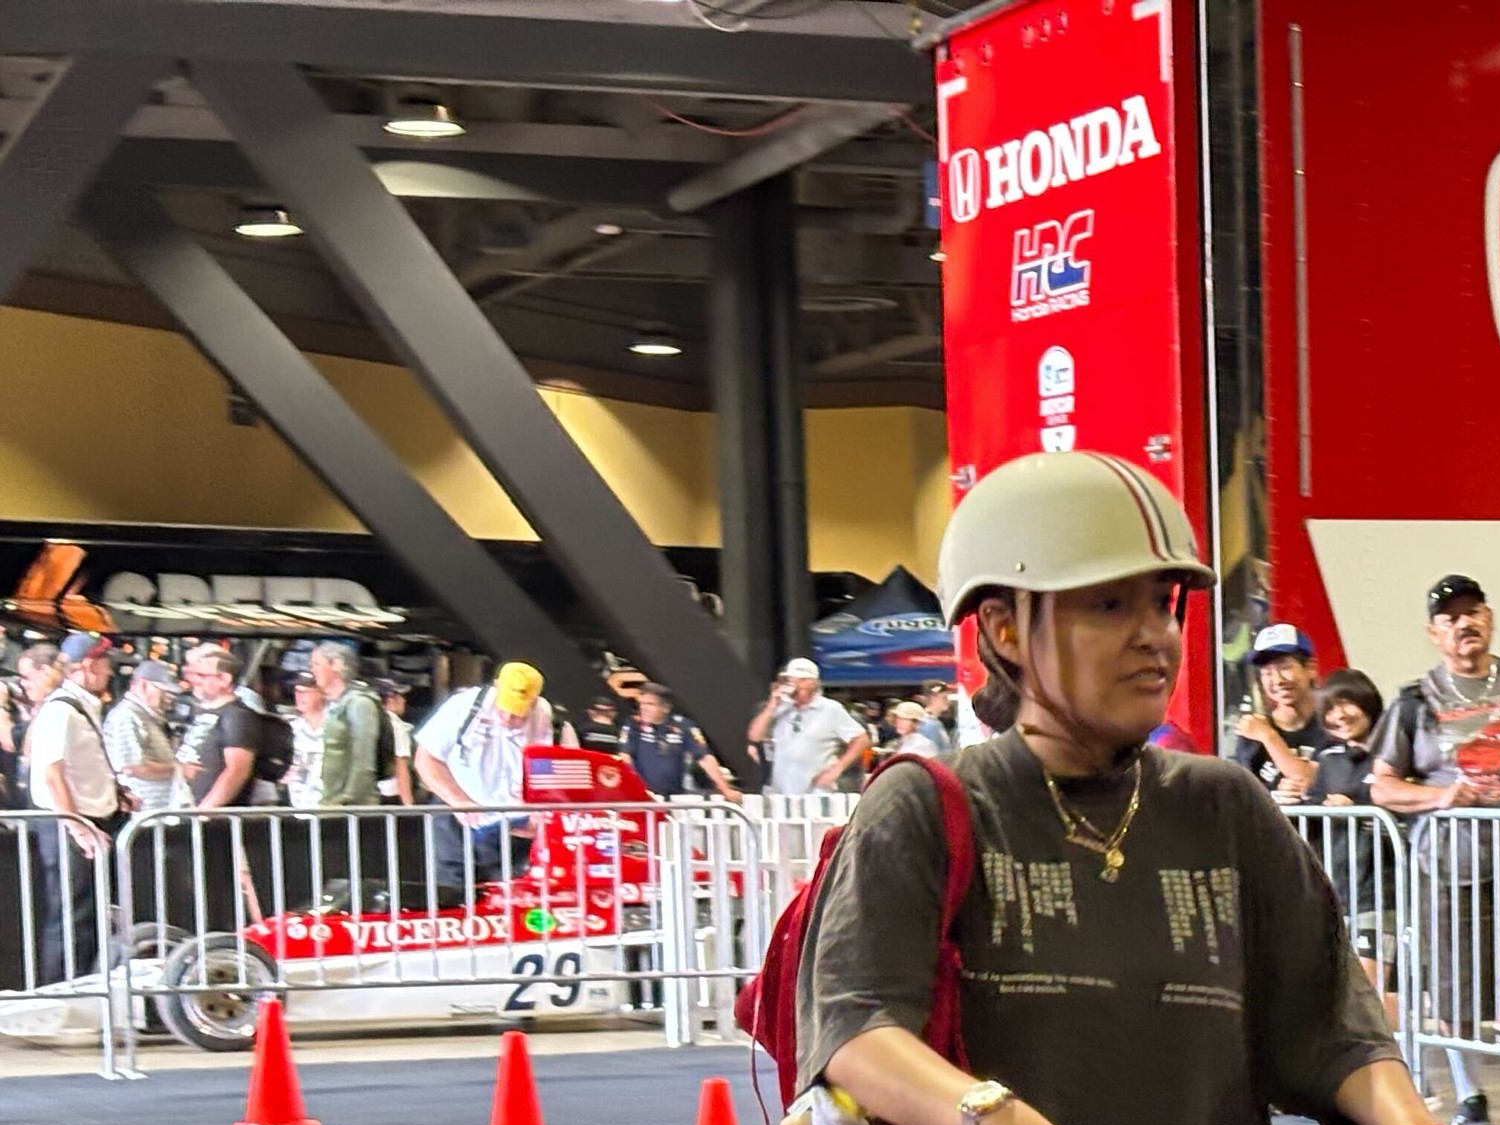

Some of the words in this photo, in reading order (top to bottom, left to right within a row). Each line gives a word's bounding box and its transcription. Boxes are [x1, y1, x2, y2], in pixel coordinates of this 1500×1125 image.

[985, 94, 1161, 209] HONDA
[340, 914, 510, 949] VICEROY
[504, 951, 582, 1012] 29
